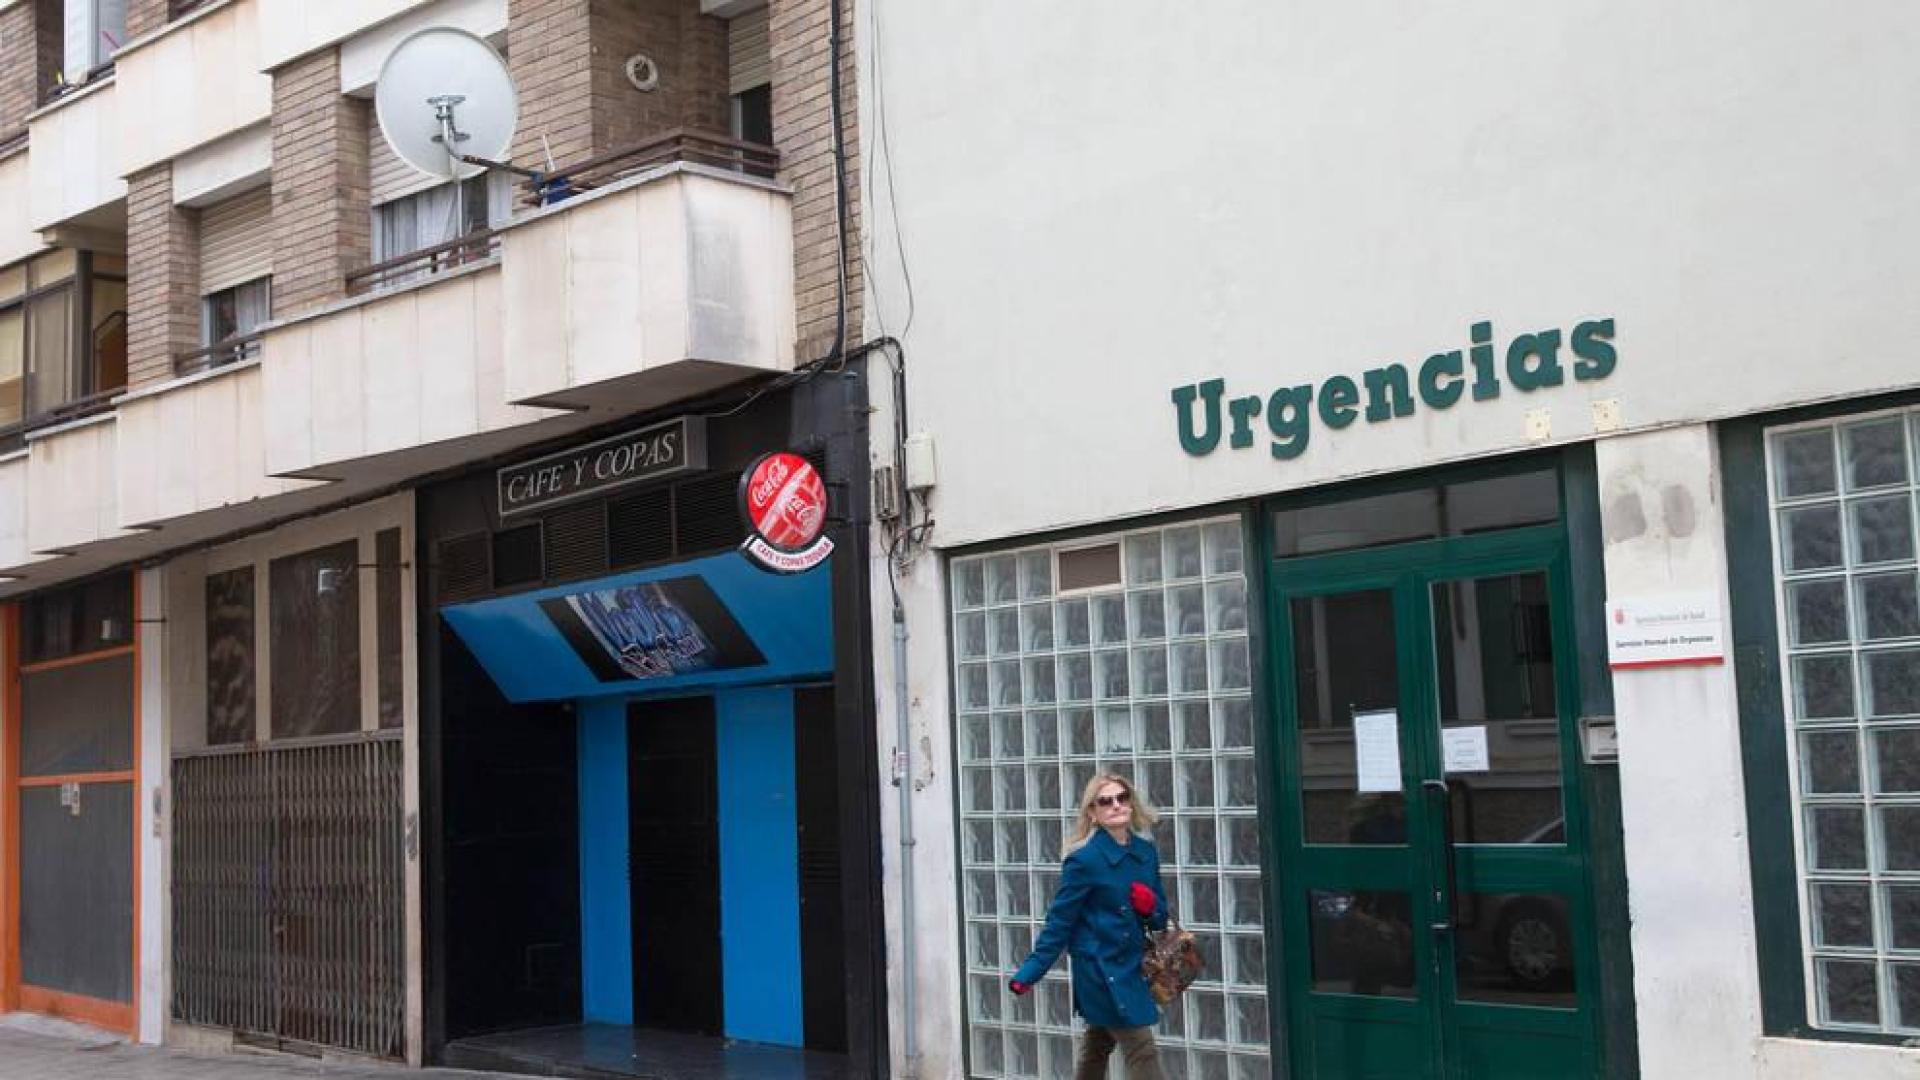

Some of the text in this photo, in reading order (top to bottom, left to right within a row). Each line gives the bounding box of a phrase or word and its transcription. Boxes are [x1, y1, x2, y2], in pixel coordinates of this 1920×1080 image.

[1171, 317, 1618, 461] Urgencias
[507, 432, 676, 503] CAFE Y COPAS
